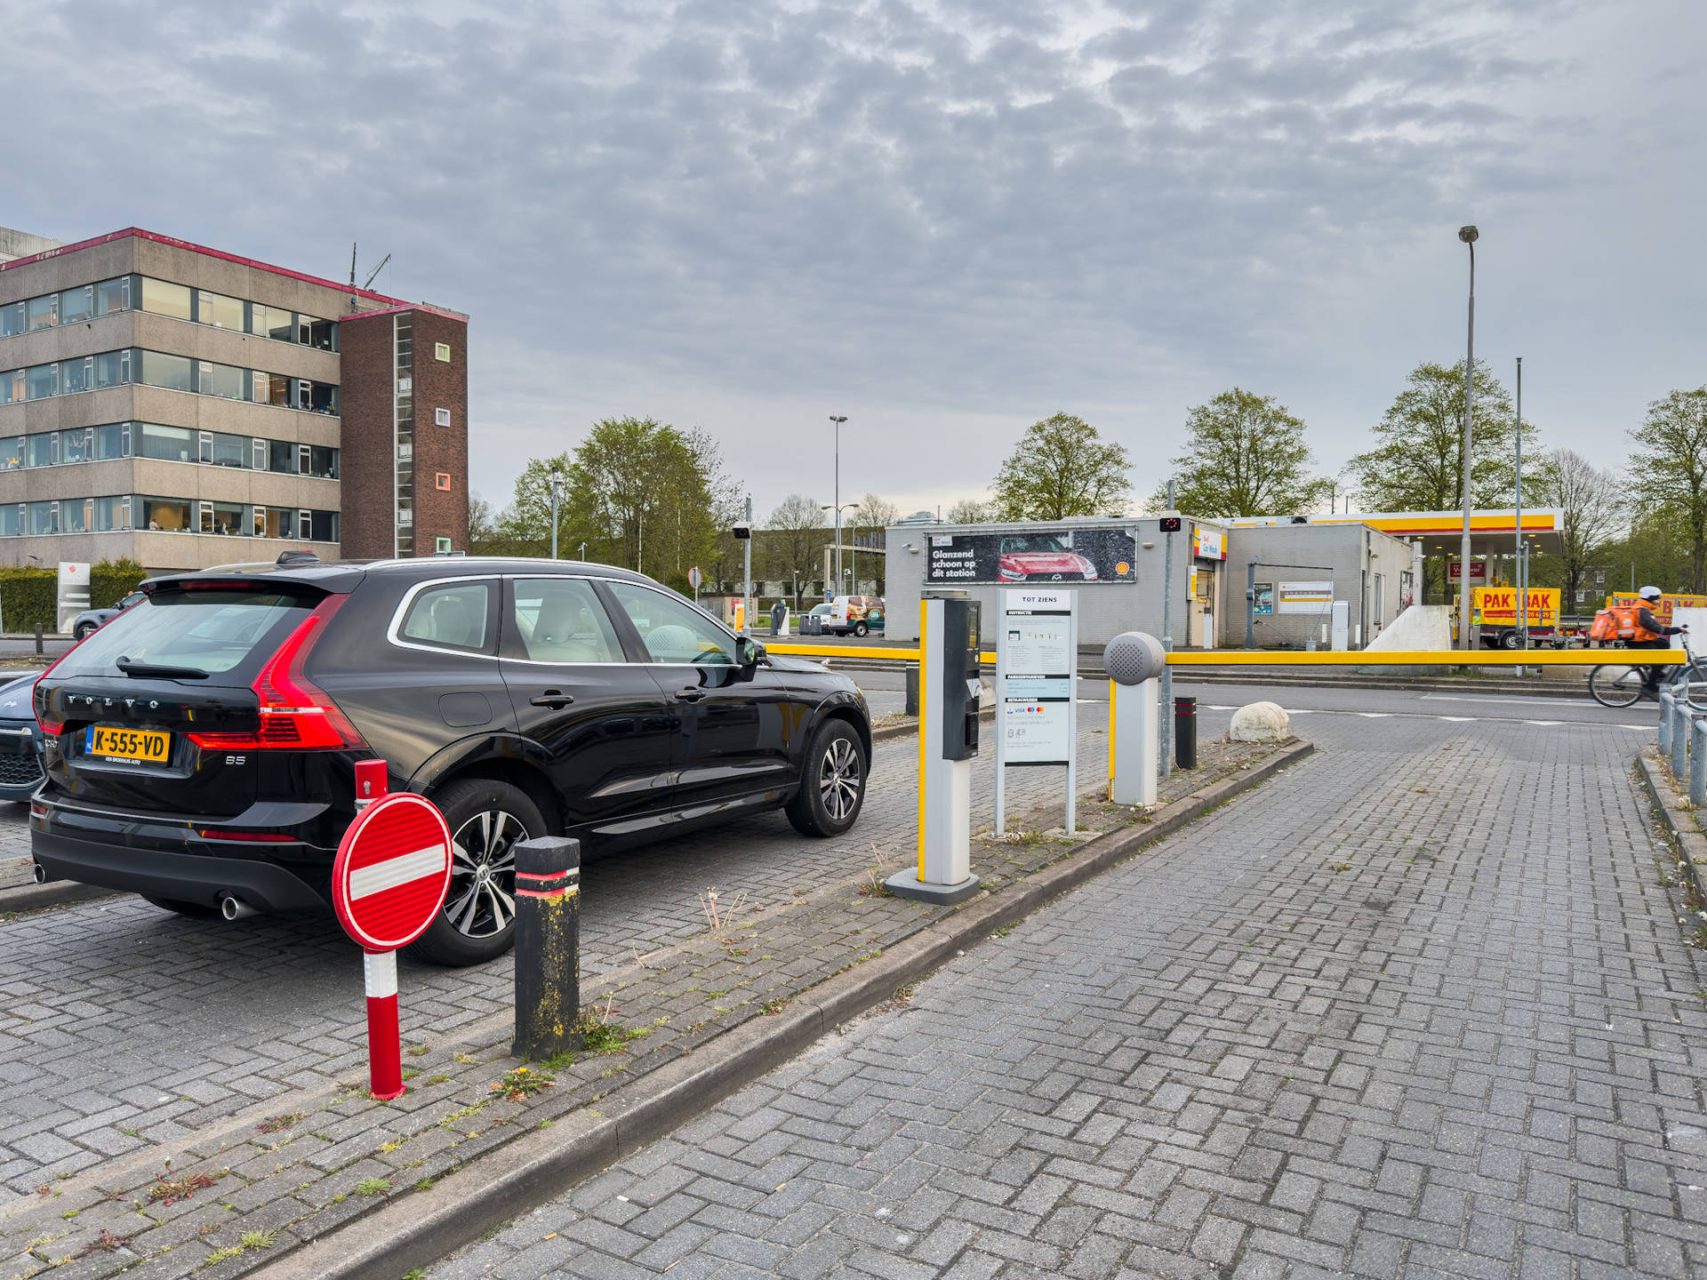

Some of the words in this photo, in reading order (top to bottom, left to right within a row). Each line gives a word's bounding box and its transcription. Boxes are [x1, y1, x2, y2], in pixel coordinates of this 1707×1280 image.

[932, 549, 974, 559] Glanzend
[932, 559, 962, 568] schoon
[964, 561, 976, 570] op
[932, 568, 944, 577] dit
[945, 568, 976, 577] station
[1483, 593, 1511, 609] PAK
[67, 695, 159, 709] VOLVO
[95, 730, 164, 757] K-555-VD
[226, 755, 246, 765] B5
